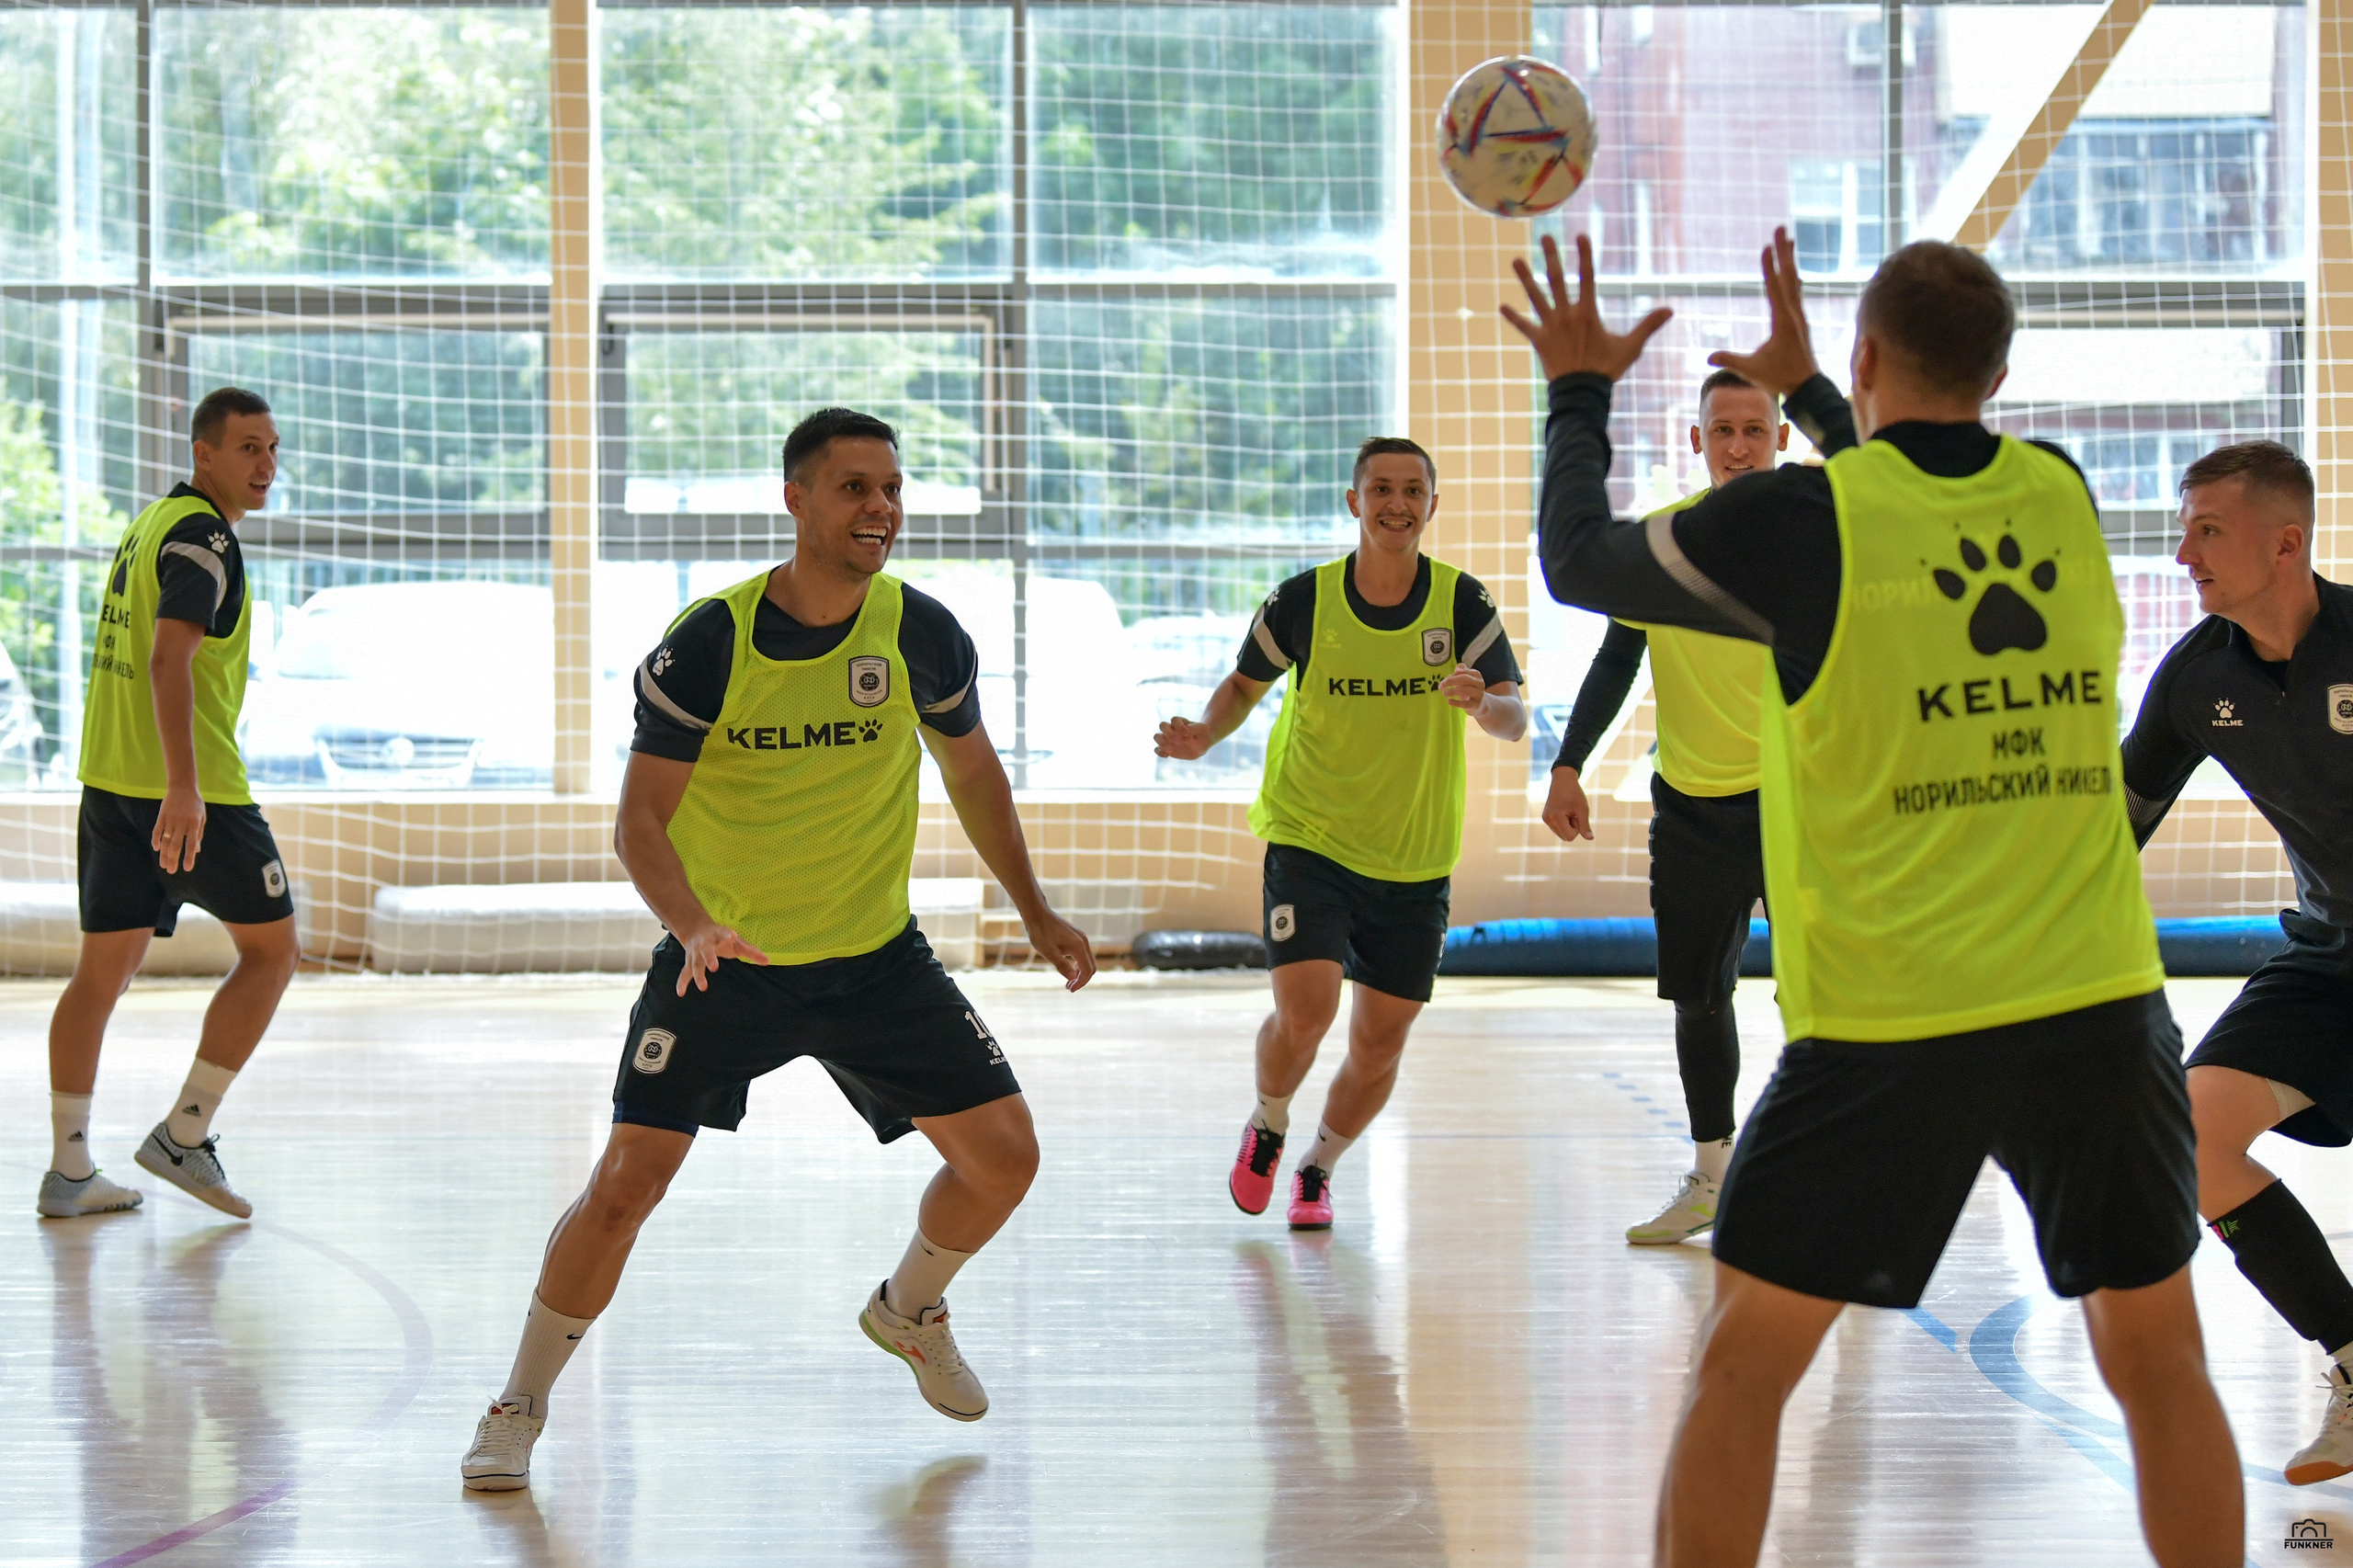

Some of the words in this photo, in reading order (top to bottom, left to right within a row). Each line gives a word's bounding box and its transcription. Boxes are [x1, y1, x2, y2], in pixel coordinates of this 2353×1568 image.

[101, 604, 131, 629] ELME
[1329, 677, 1427, 697] KELME
[1917, 670, 2102, 722] KELME
[727, 722, 857, 750] KELME
